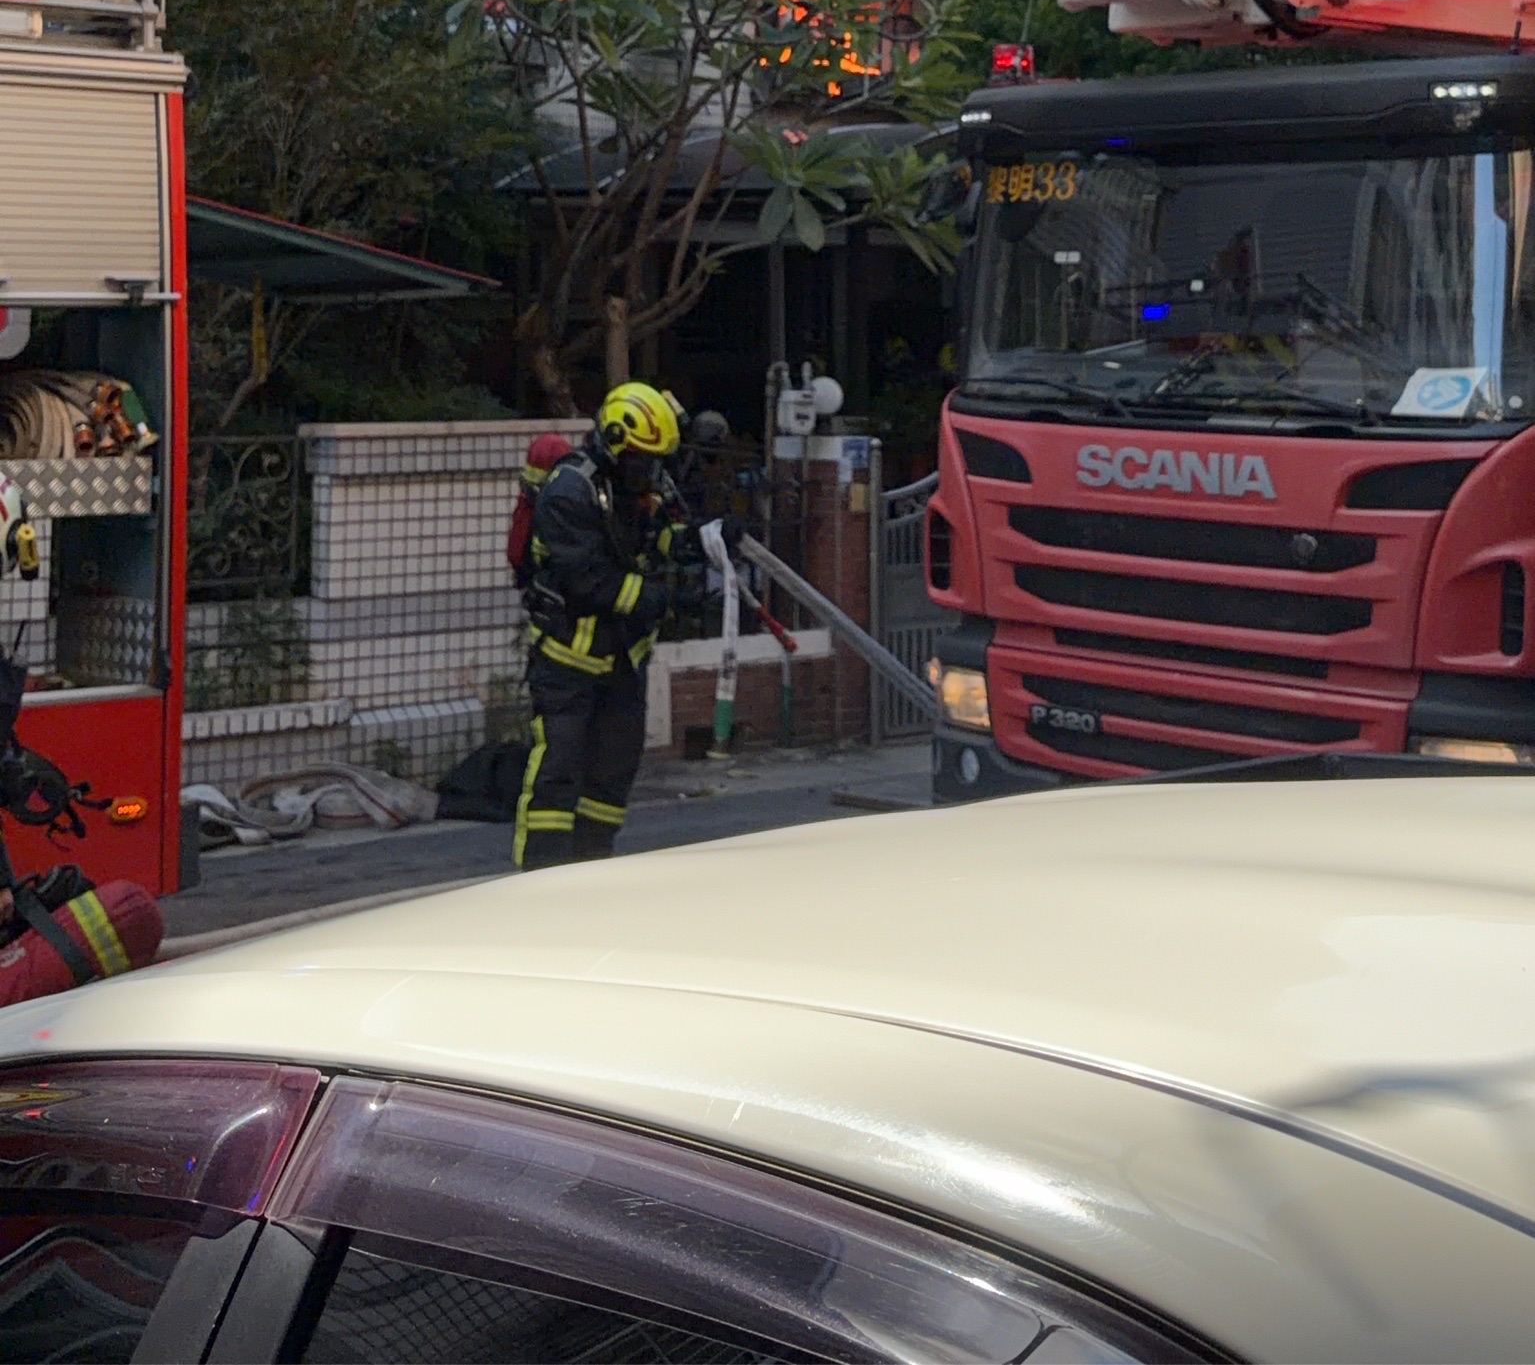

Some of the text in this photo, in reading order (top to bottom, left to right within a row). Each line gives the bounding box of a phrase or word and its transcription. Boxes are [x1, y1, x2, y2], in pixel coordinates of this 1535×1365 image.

[1076, 444, 1277, 500] SCANIA
[1032, 705, 1096, 733] P 320
